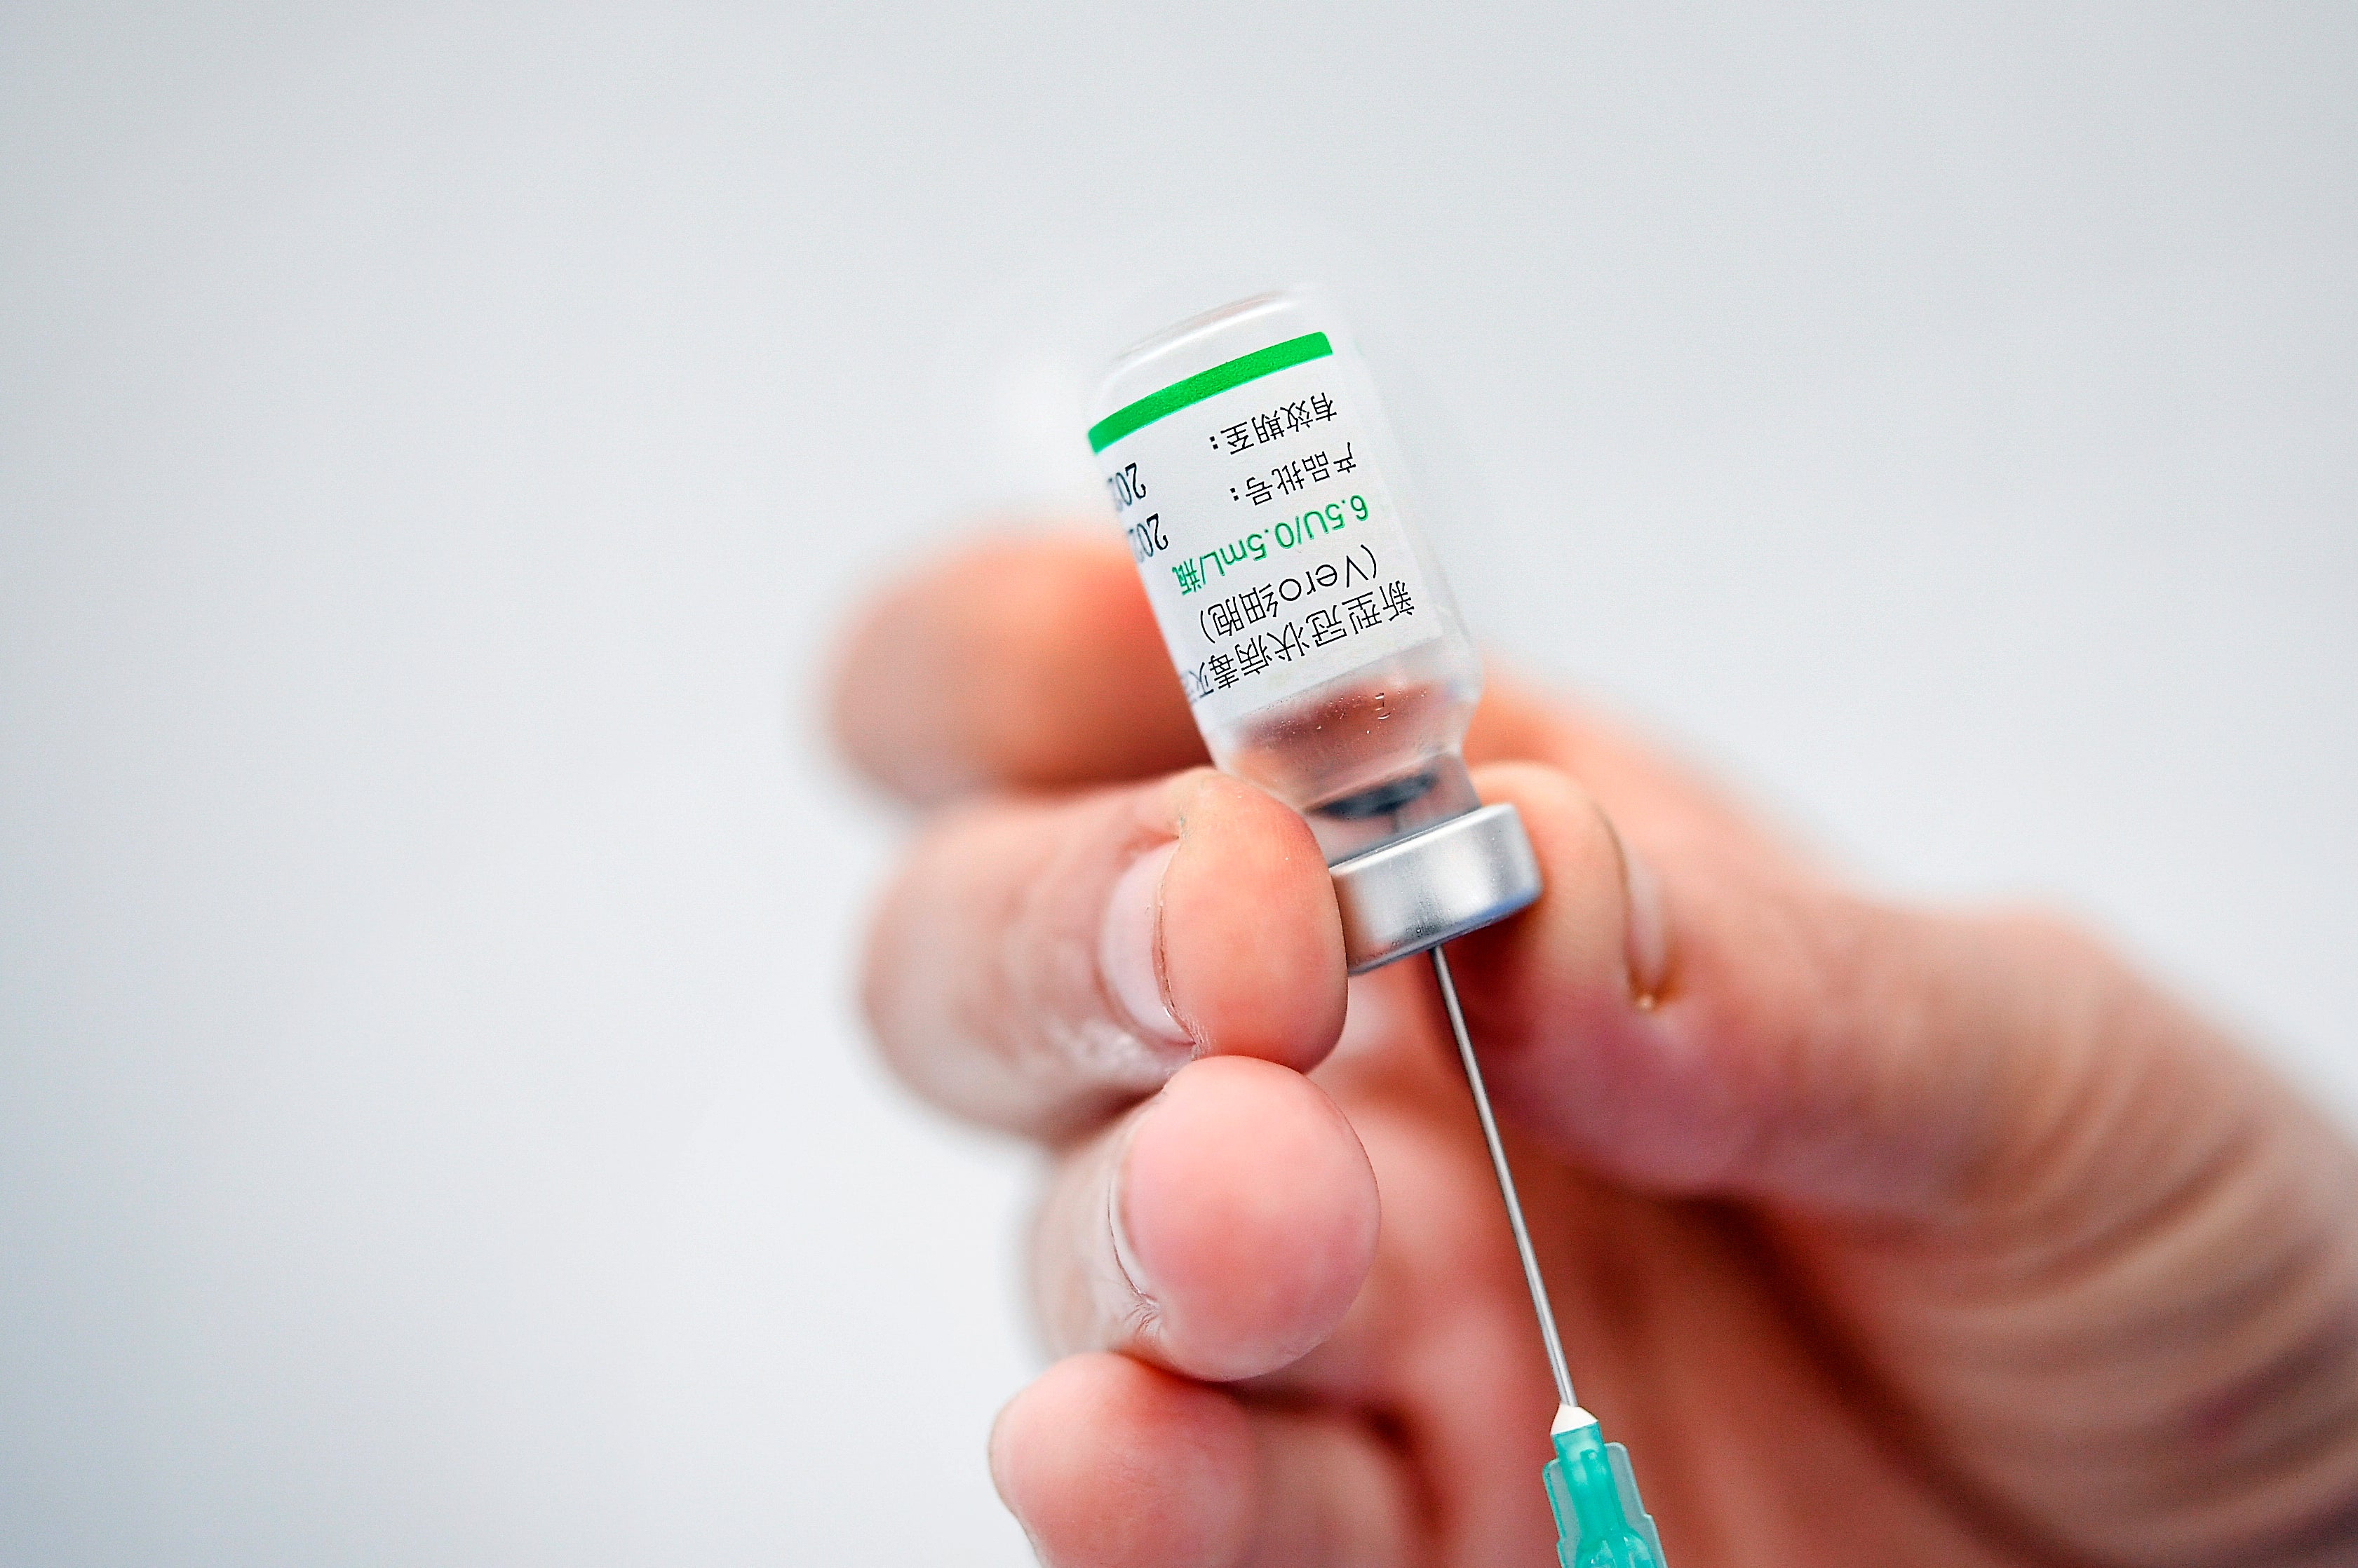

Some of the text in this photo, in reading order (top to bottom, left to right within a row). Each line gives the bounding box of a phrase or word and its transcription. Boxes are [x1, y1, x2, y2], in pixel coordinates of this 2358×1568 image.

[1209, 392, 1337, 454] 有效期至：
[1229, 442, 1356, 506] 产品批号：
